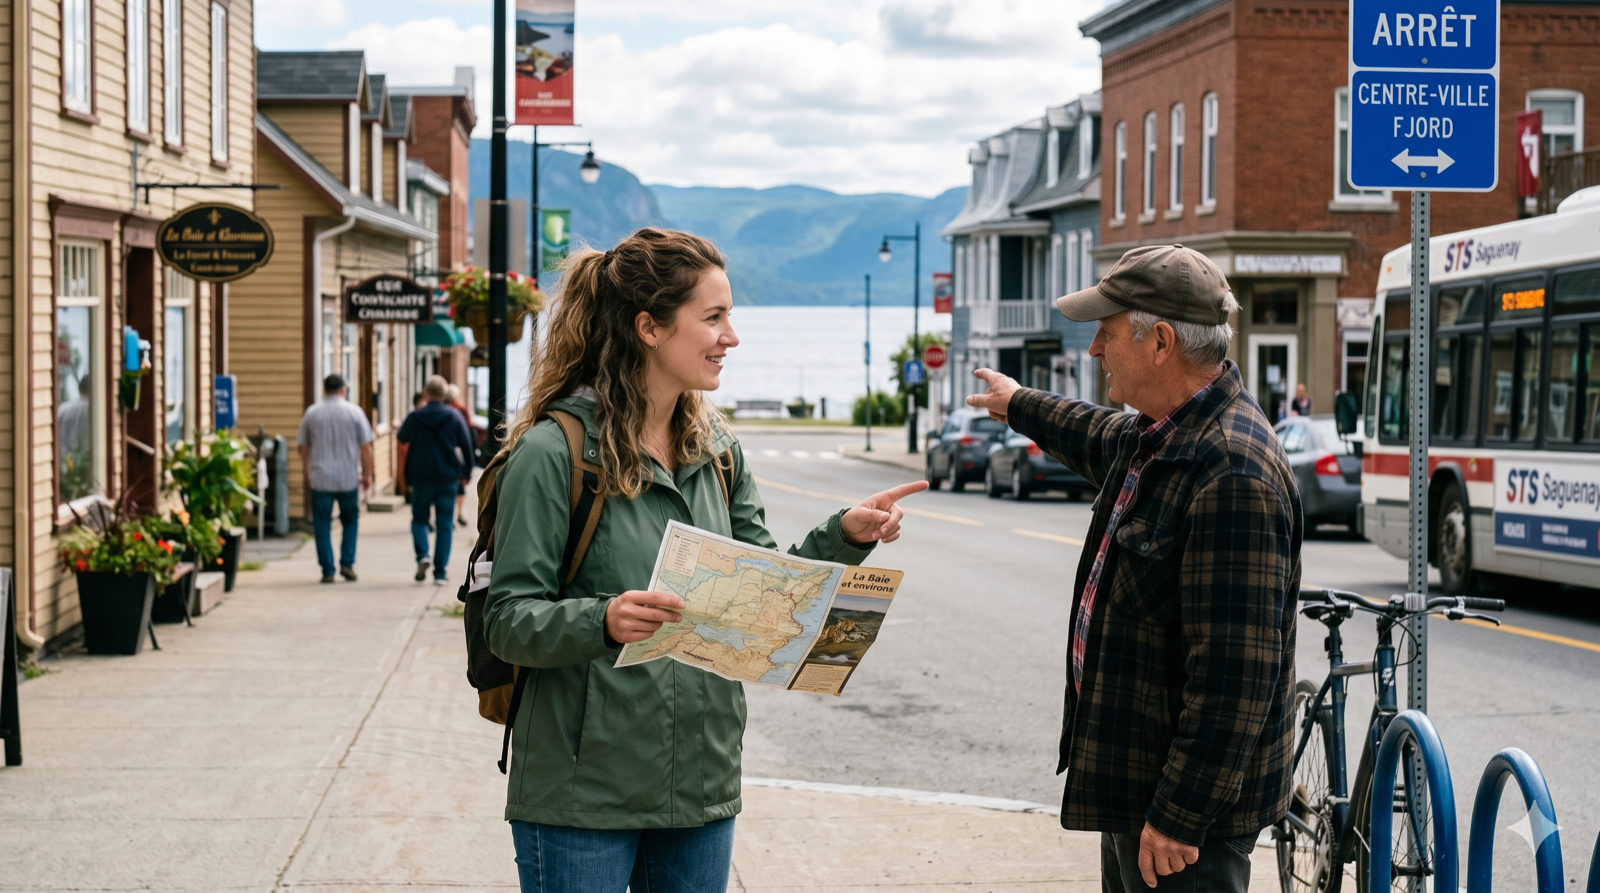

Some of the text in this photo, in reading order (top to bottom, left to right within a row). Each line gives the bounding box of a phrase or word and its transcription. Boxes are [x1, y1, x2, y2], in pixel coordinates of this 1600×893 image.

[1372, 6, 1477, 47] ARRÊT
[1358, 83, 1489, 107] CENTRE-VILLE
[1393, 116, 1454, 139] FJORD
[1444, 239, 1521, 272] STS Saguenay
[1506, 469, 1539, 505] STS
[853, 572, 891, 583] La Baie
[854, 583, 894, 592] environs
